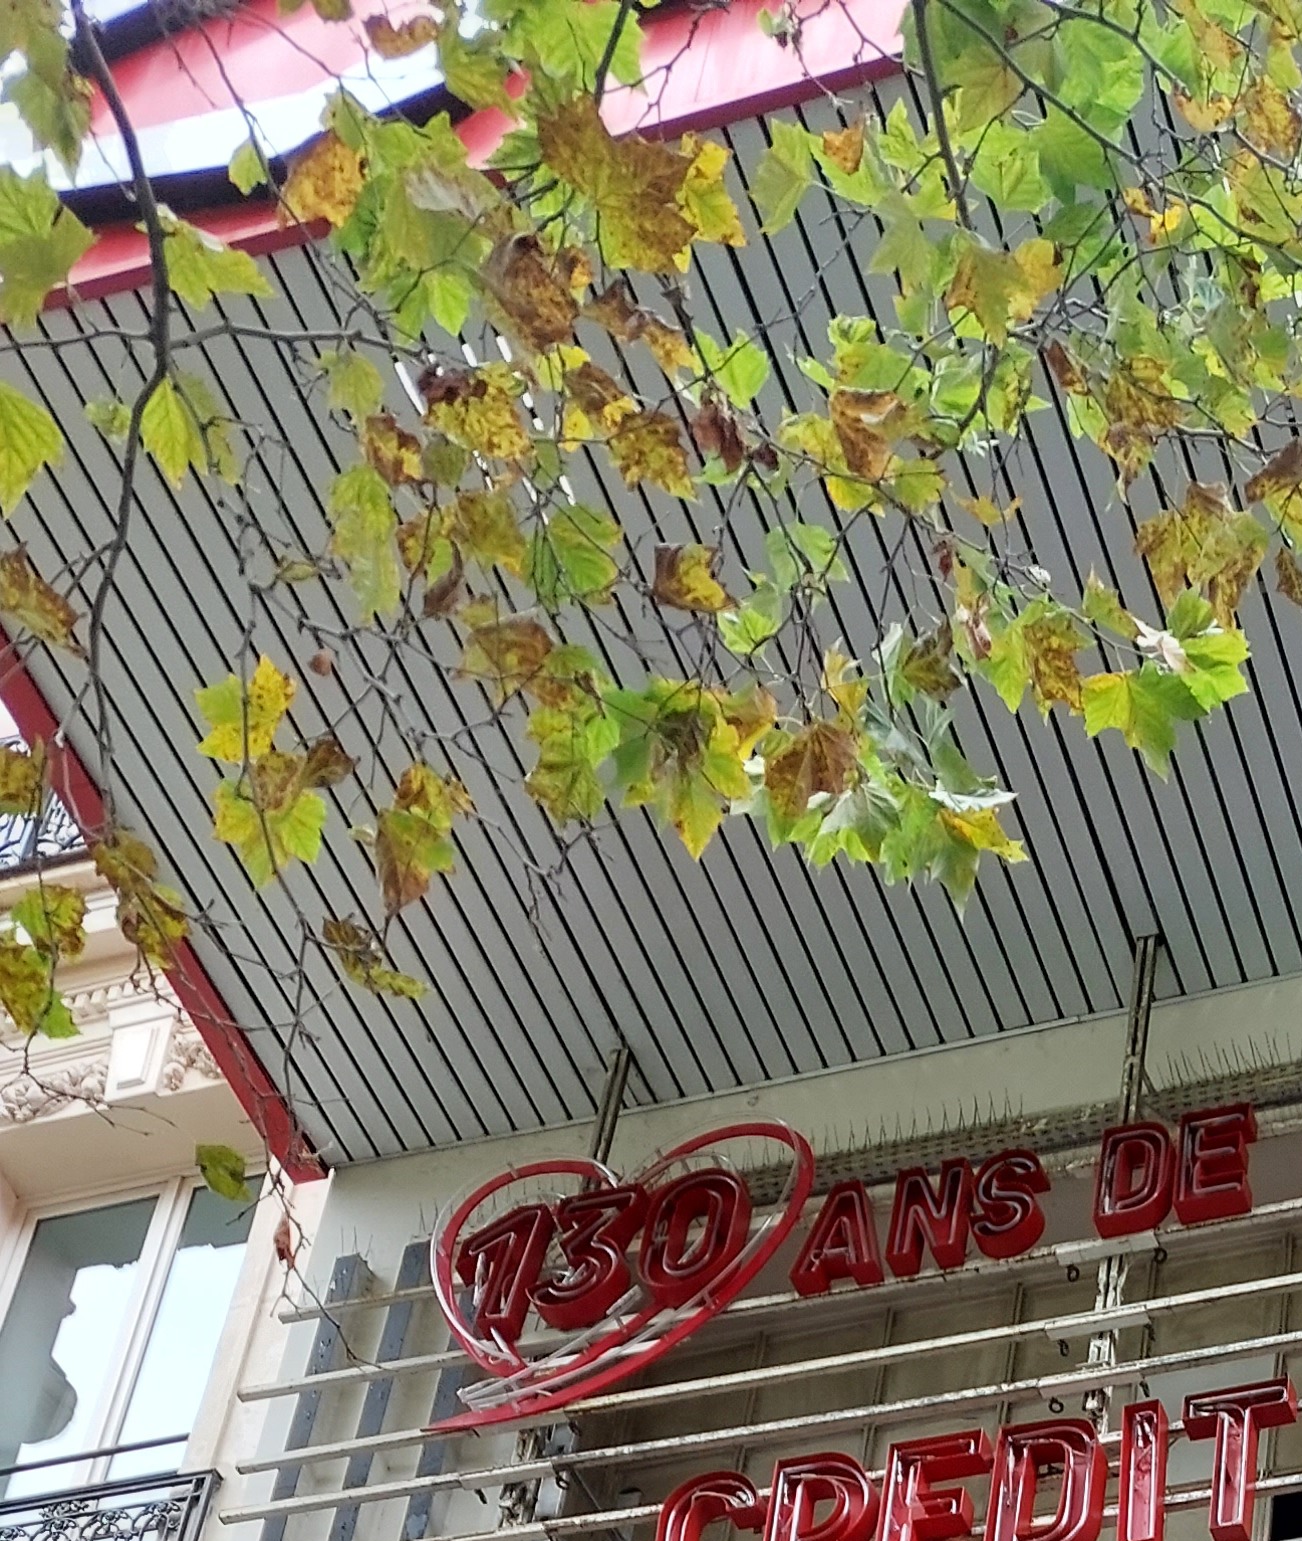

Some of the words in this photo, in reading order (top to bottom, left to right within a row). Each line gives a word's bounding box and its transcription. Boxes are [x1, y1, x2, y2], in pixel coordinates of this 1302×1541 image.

[456, 1166, 752, 1342] 130
[790, 1148, 1050, 1297] ANS
[1094, 1102, 1259, 1239] DE
